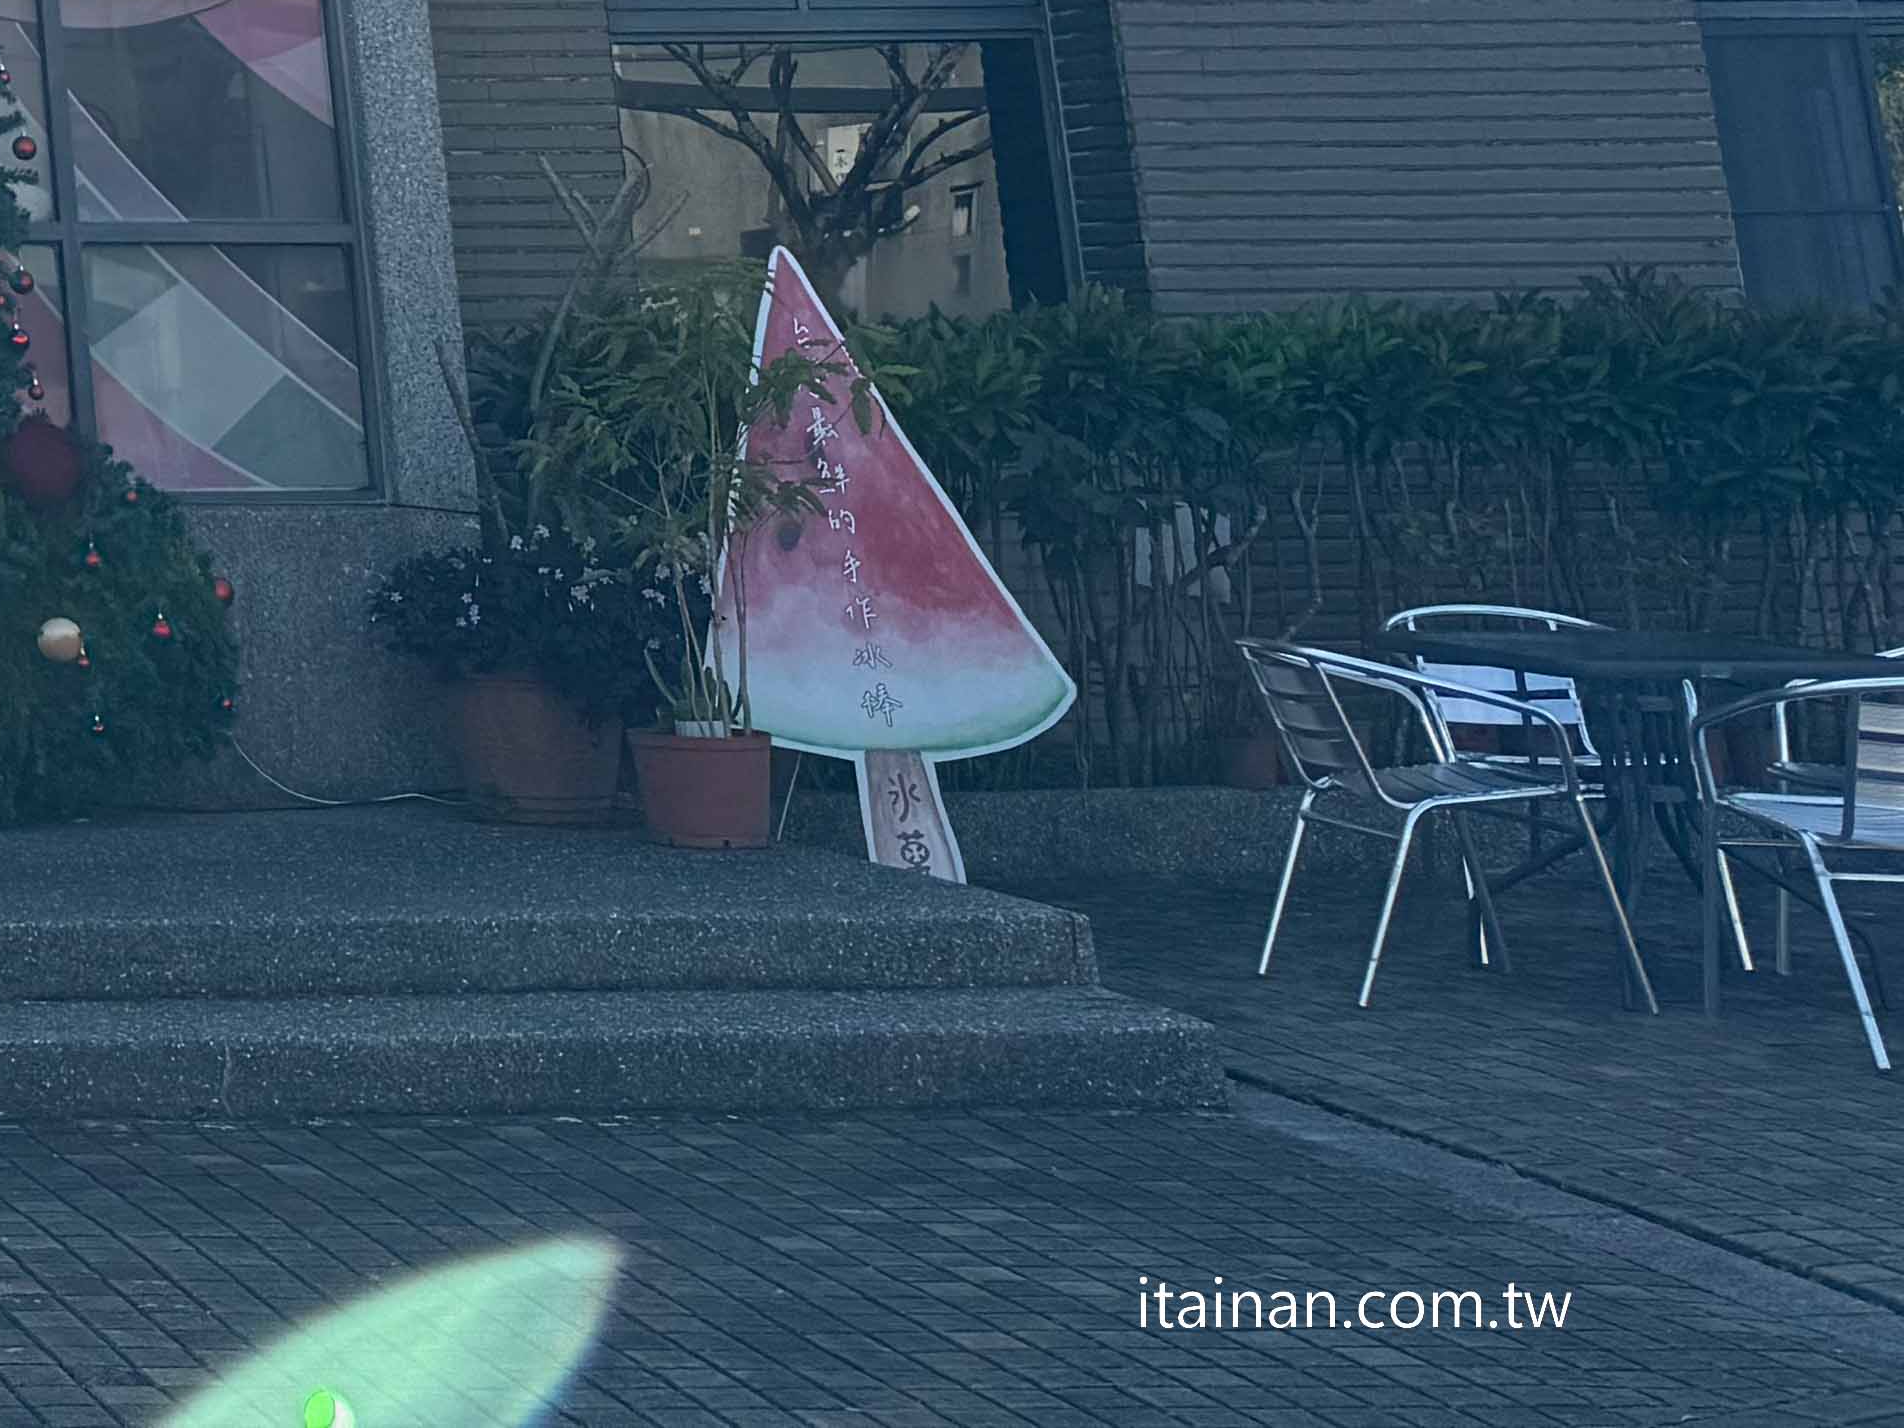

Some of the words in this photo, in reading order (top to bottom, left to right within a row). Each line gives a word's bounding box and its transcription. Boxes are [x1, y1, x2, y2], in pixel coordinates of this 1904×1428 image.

[792, 316, 904, 729] 台最鮮的手作冰棒
